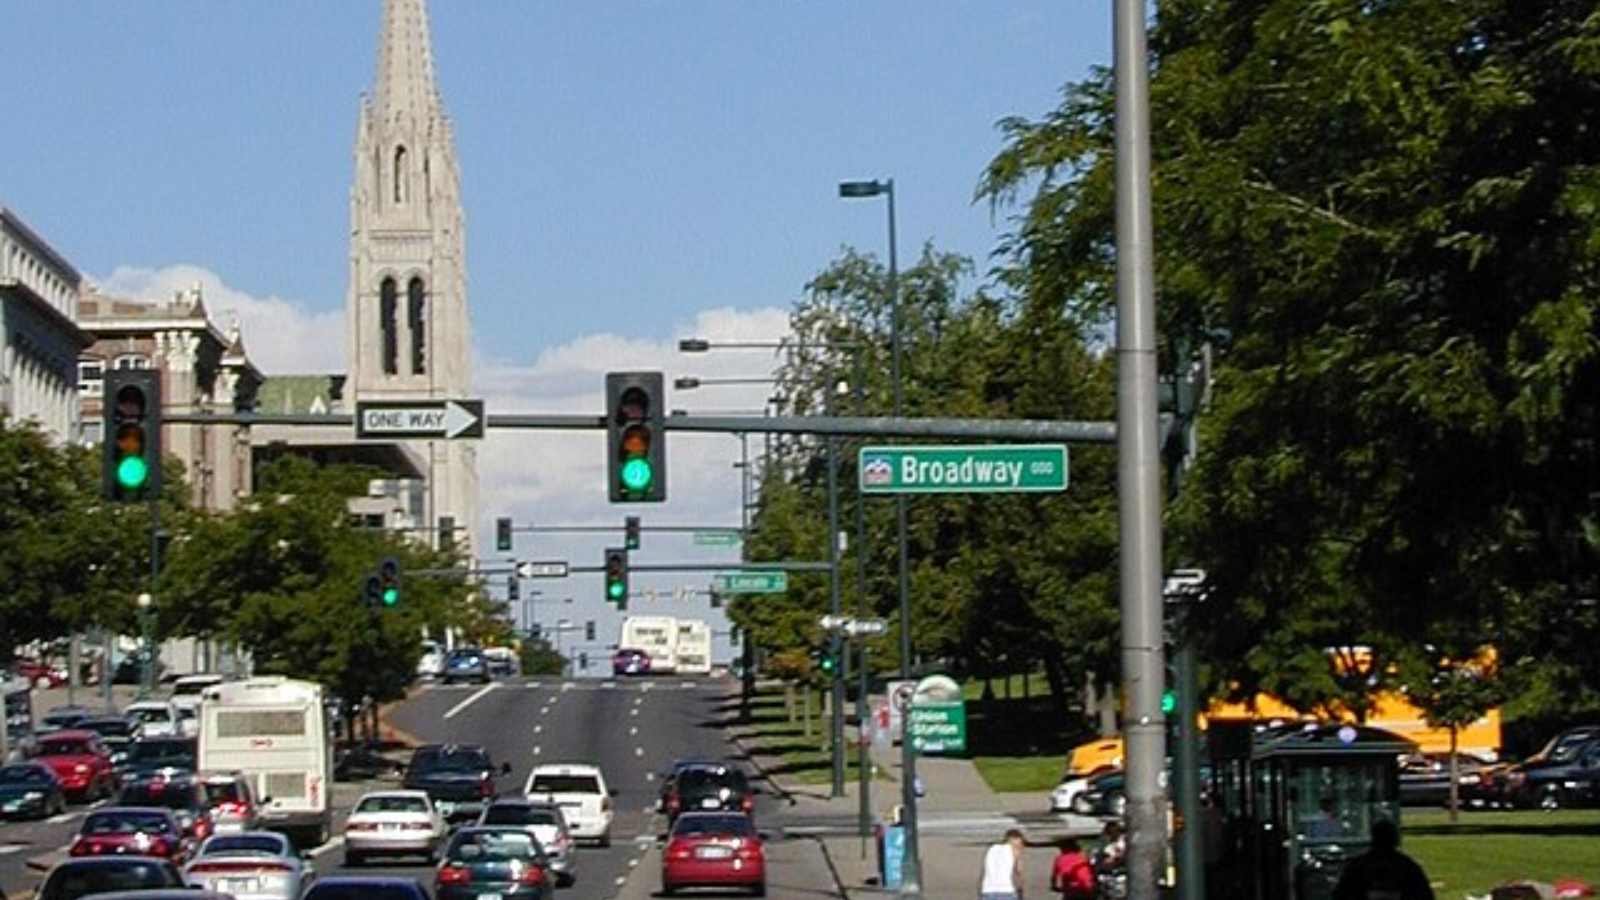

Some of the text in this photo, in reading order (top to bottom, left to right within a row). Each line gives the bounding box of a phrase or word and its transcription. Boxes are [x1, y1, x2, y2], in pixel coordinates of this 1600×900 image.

[368, 411, 445, 427] ONE WAY
[901, 456, 1023, 485] Broadway
